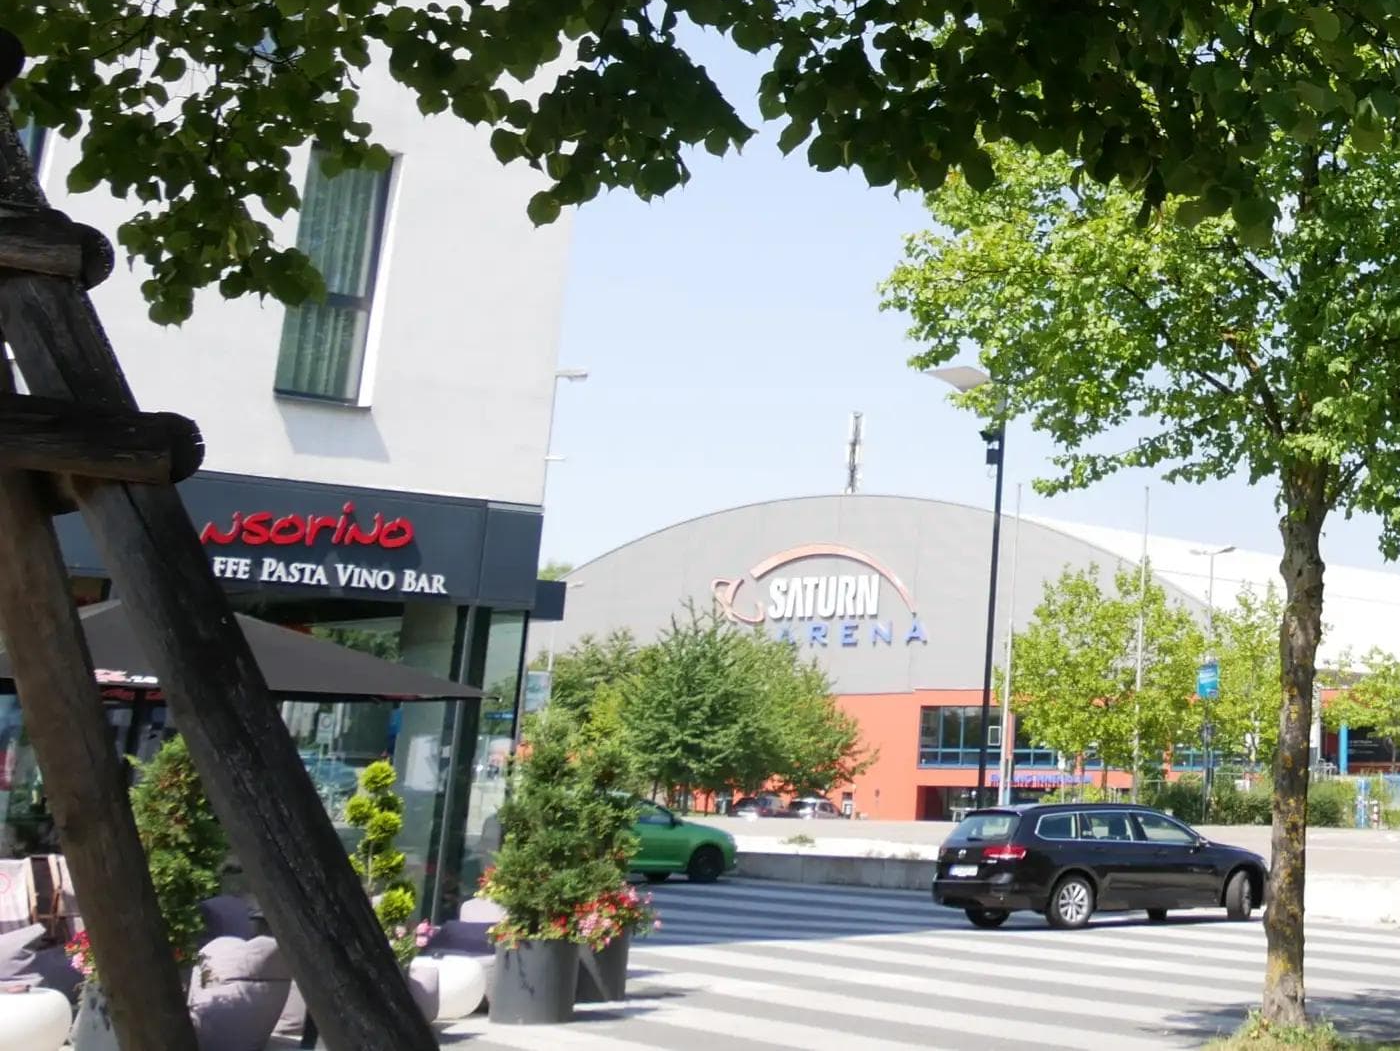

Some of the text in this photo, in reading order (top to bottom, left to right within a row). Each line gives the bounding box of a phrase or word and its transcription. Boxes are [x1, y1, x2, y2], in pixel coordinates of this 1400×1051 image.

[260, 557, 328, 586] PASTA
[334, 564, 396, 590] VINO
[401, 569, 447, 594] BAR
[767, 574, 880, 619] SATURN
[779, 620, 928, 646] ARENA
